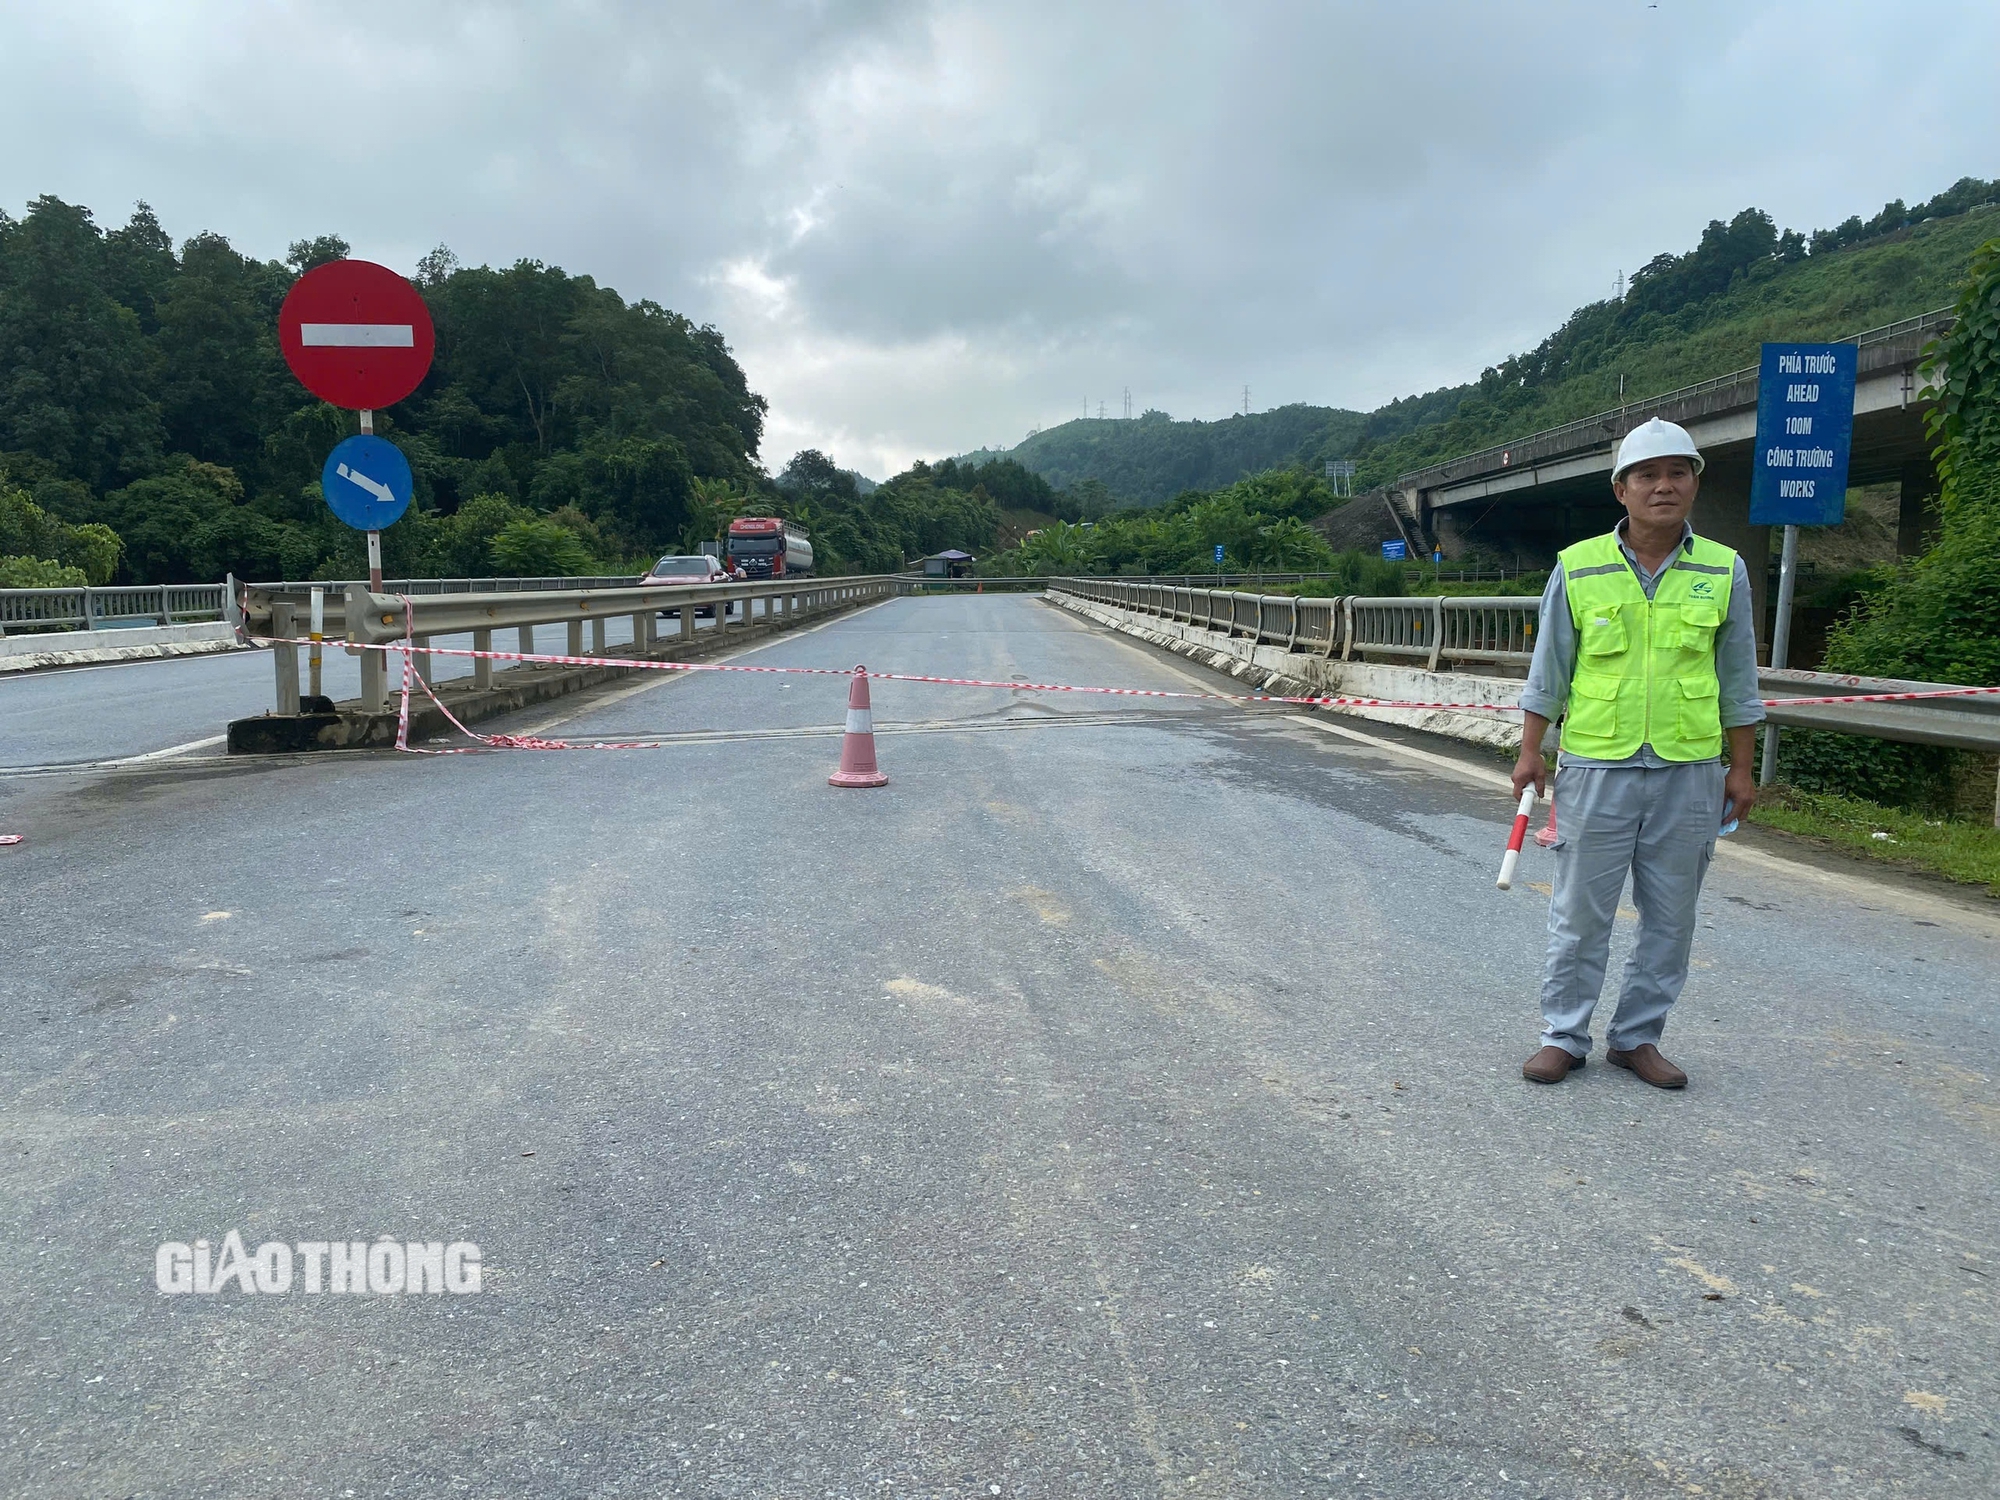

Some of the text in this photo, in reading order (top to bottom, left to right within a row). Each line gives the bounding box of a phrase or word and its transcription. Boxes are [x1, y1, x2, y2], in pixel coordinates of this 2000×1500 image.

[1779, 351, 1836, 374] PHÍA TRƯỚC
[1786, 384, 1819, 402] AHEAD
[1785, 417, 1813, 435] 100M
[1766, 446, 1833, 468] CÔNG TRƯỜNG
[1780, 479, 1816, 498] WORKS
